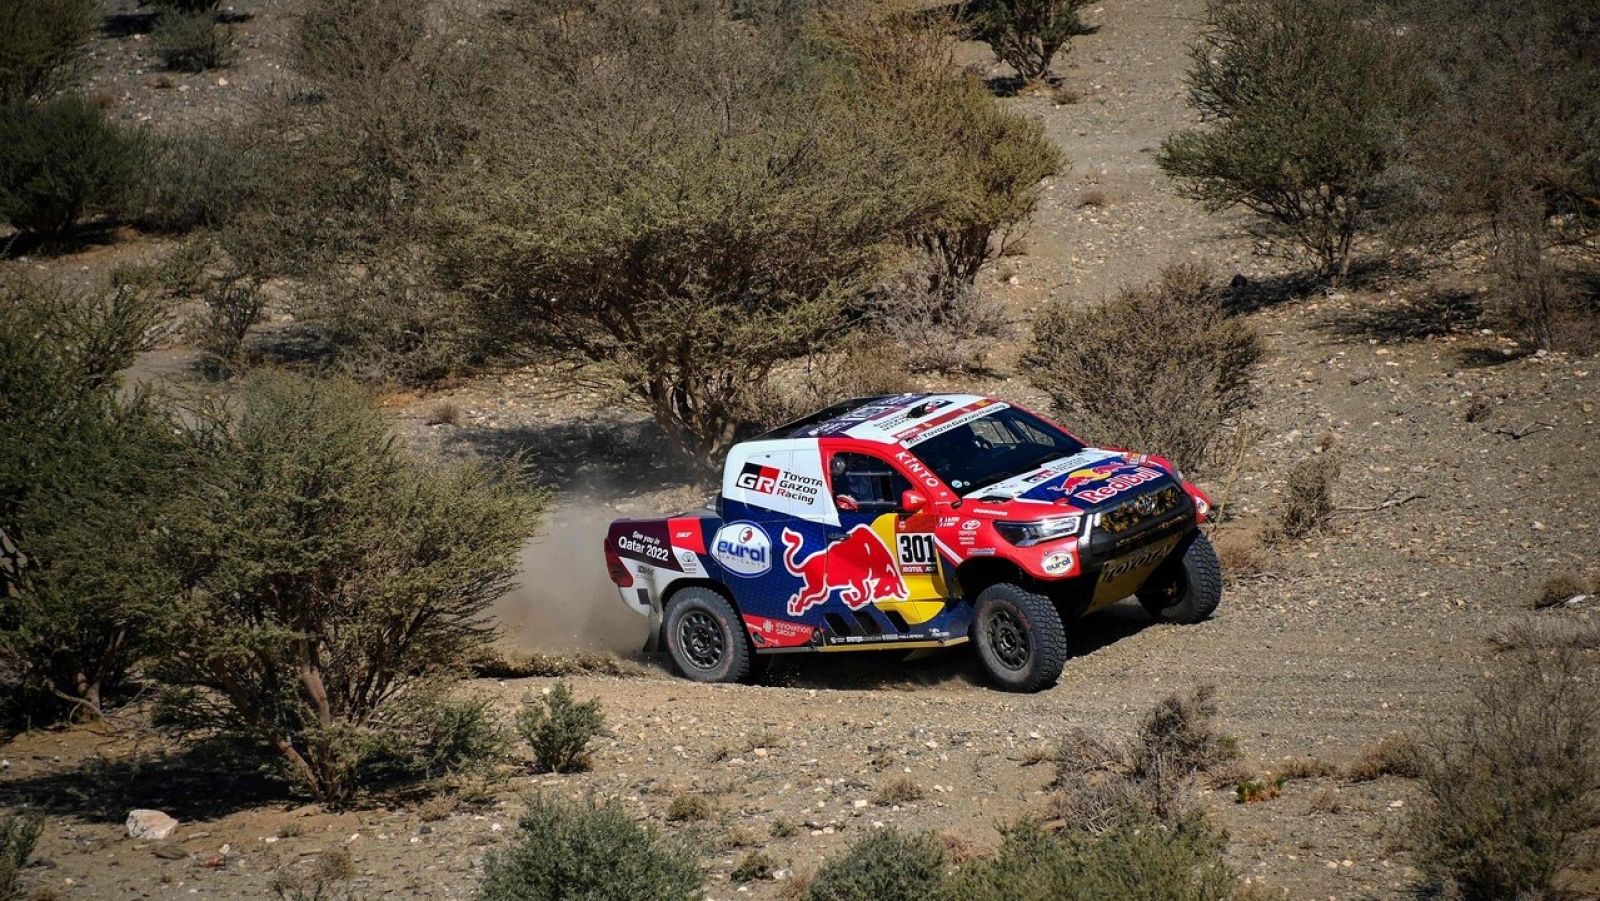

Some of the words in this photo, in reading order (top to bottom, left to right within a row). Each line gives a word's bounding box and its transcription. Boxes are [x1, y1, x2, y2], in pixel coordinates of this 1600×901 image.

[737, 472, 775, 493] GR
[780, 480, 817, 495] GAZOO
[783, 471, 823, 487] TOYOTA
[777, 488, 815, 505] Racing
[618, 536, 645, 554] Qatar
[646, 545, 669, 562] 2022
[718, 541, 765, 563] eurol
[900, 535, 936, 563] 301
[1046, 556, 1071, 572] eurol
